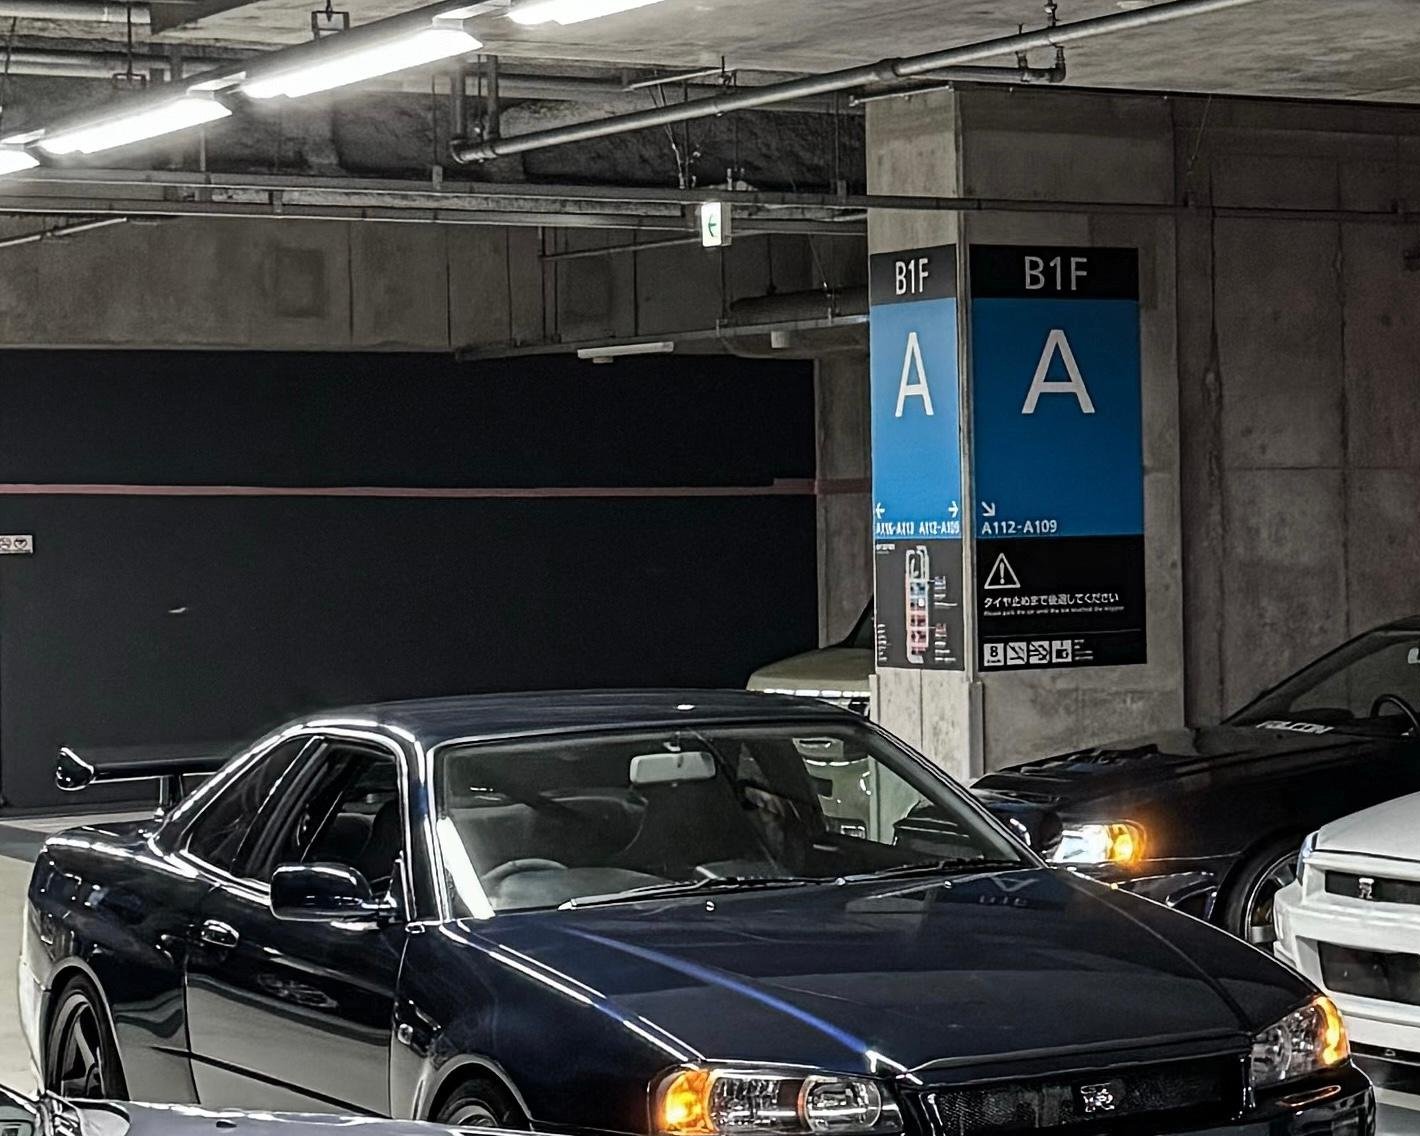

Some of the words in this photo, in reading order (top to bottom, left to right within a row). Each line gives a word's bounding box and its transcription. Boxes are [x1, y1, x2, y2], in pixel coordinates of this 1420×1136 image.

[895, 257, 929, 296] B1F
[1024, 255, 1088, 291] B1F
[895, 331, 935, 418] A
[1021, 329, 1096, 415] A
[981, 519, 1058, 535] A112-A109
